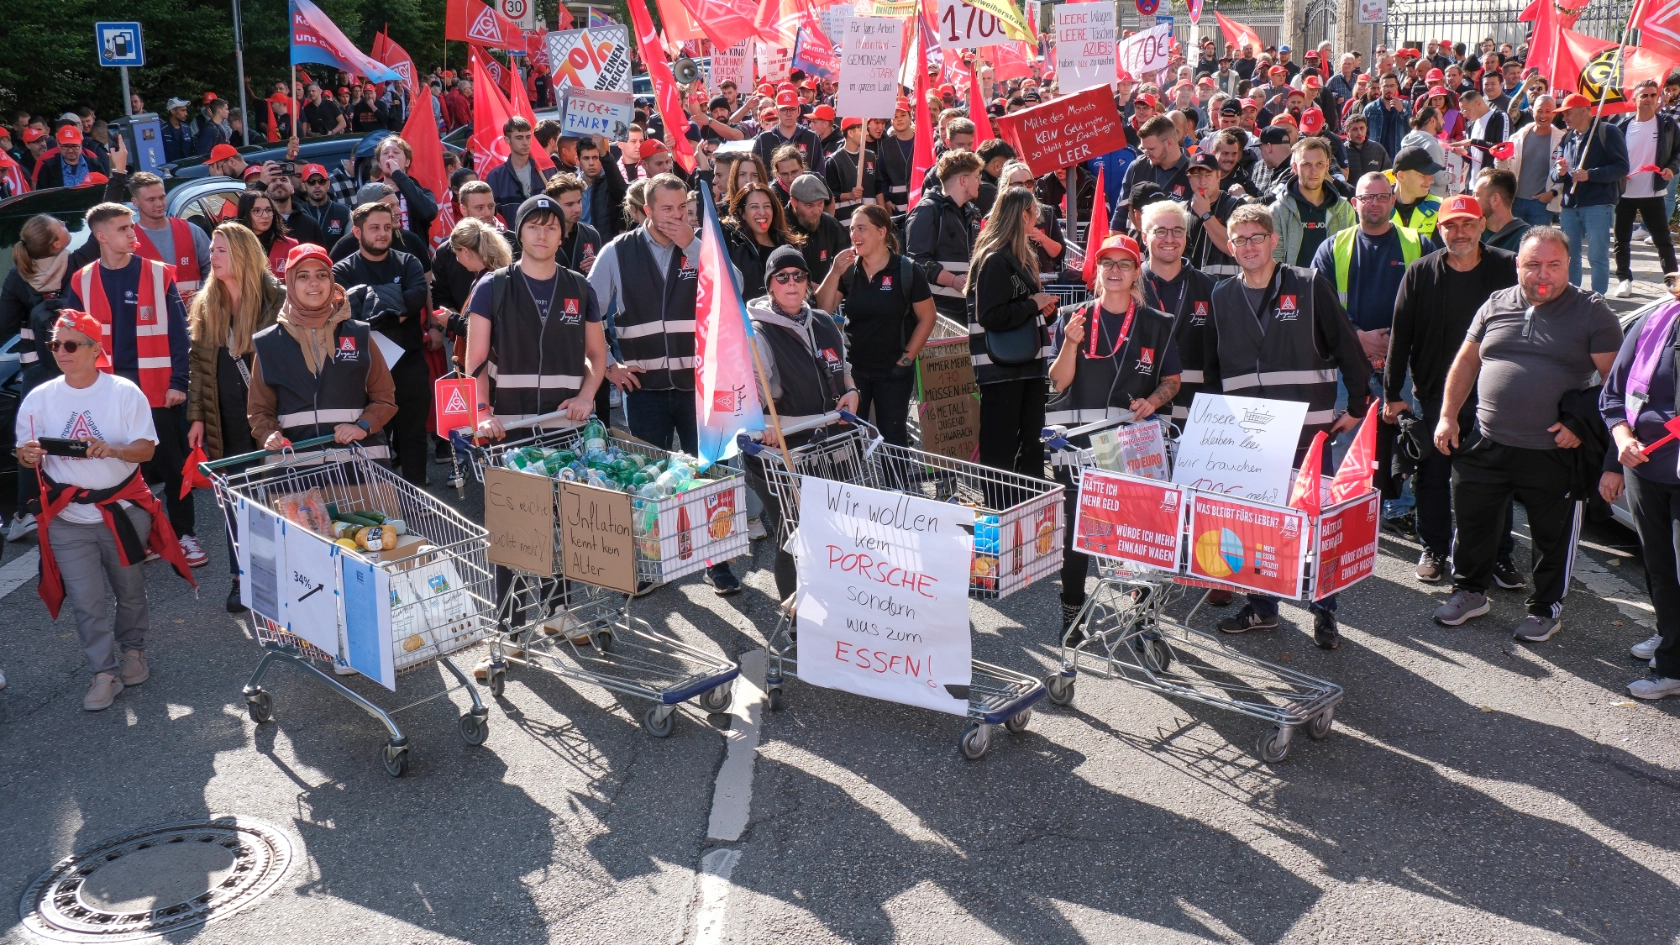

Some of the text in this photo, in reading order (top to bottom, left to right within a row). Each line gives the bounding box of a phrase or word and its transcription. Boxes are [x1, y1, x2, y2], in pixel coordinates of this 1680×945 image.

[507, 0, 522, 12] 30
[1060, 12, 1088, 25] LEERE
[1060, 28, 1088, 42] LEERE
[1083, 42, 1113, 56] AZUBIS
[1124, 33, 1168, 71] 170€
[604, 44, 625, 75] EINEN
[594, 73, 608, 90] AUF
[568, 113, 609, 133] FAIR!
[1024, 102, 1096, 131] Mitte des Monats
[1035, 129, 1058, 145] KEIN
[1064, 122, 1084, 136] Geld
[1058, 144, 1091, 165] LEER
[927, 360, 949, 372] IMMER
[938, 371, 959, 384] 170
[924, 382, 979, 402] MÜSSEN HER
[926, 401, 968, 420] IG METALL
[1194, 398, 1236, 425] Unsere
[938, 417, 964, 430] JUGEND
[935, 427, 973, 444] SCHWABACH
[1200, 428, 1234, 446] bleiben
[958, 441, 974, 454] 170
[1127, 453, 1162, 472] 170 EURO
[1178, 452, 1262, 473] wir brauchen
[490, 482, 514, 510] Es
[1084, 479, 1118, 496] HÄTTE ICH
[826, 483, 938, 532] Wir wollen
[1082, 494, 1119, 512] MEHR GELD
[1196, 502, 1279, 529] WAS BLEIBT FÜRS LEBEN?
[570, 528, 620, 556] kennt kein
[855, 526, 890, 555] kein
[1116, 524, 1175, 547] WÜRDE ICH MEHR
[1118, 540, 1174, 562] EINKAUF WAGEN
[573, 552, 605, 577] Alter
[1342, 562, 1359, 580] EINKAUF
[293, 571, 312, 590] 34%
[847, 585, 916, 620] sondern
[846, 617, 923, 644] was zum
[835, 640, 938, 689] ESSEN!
